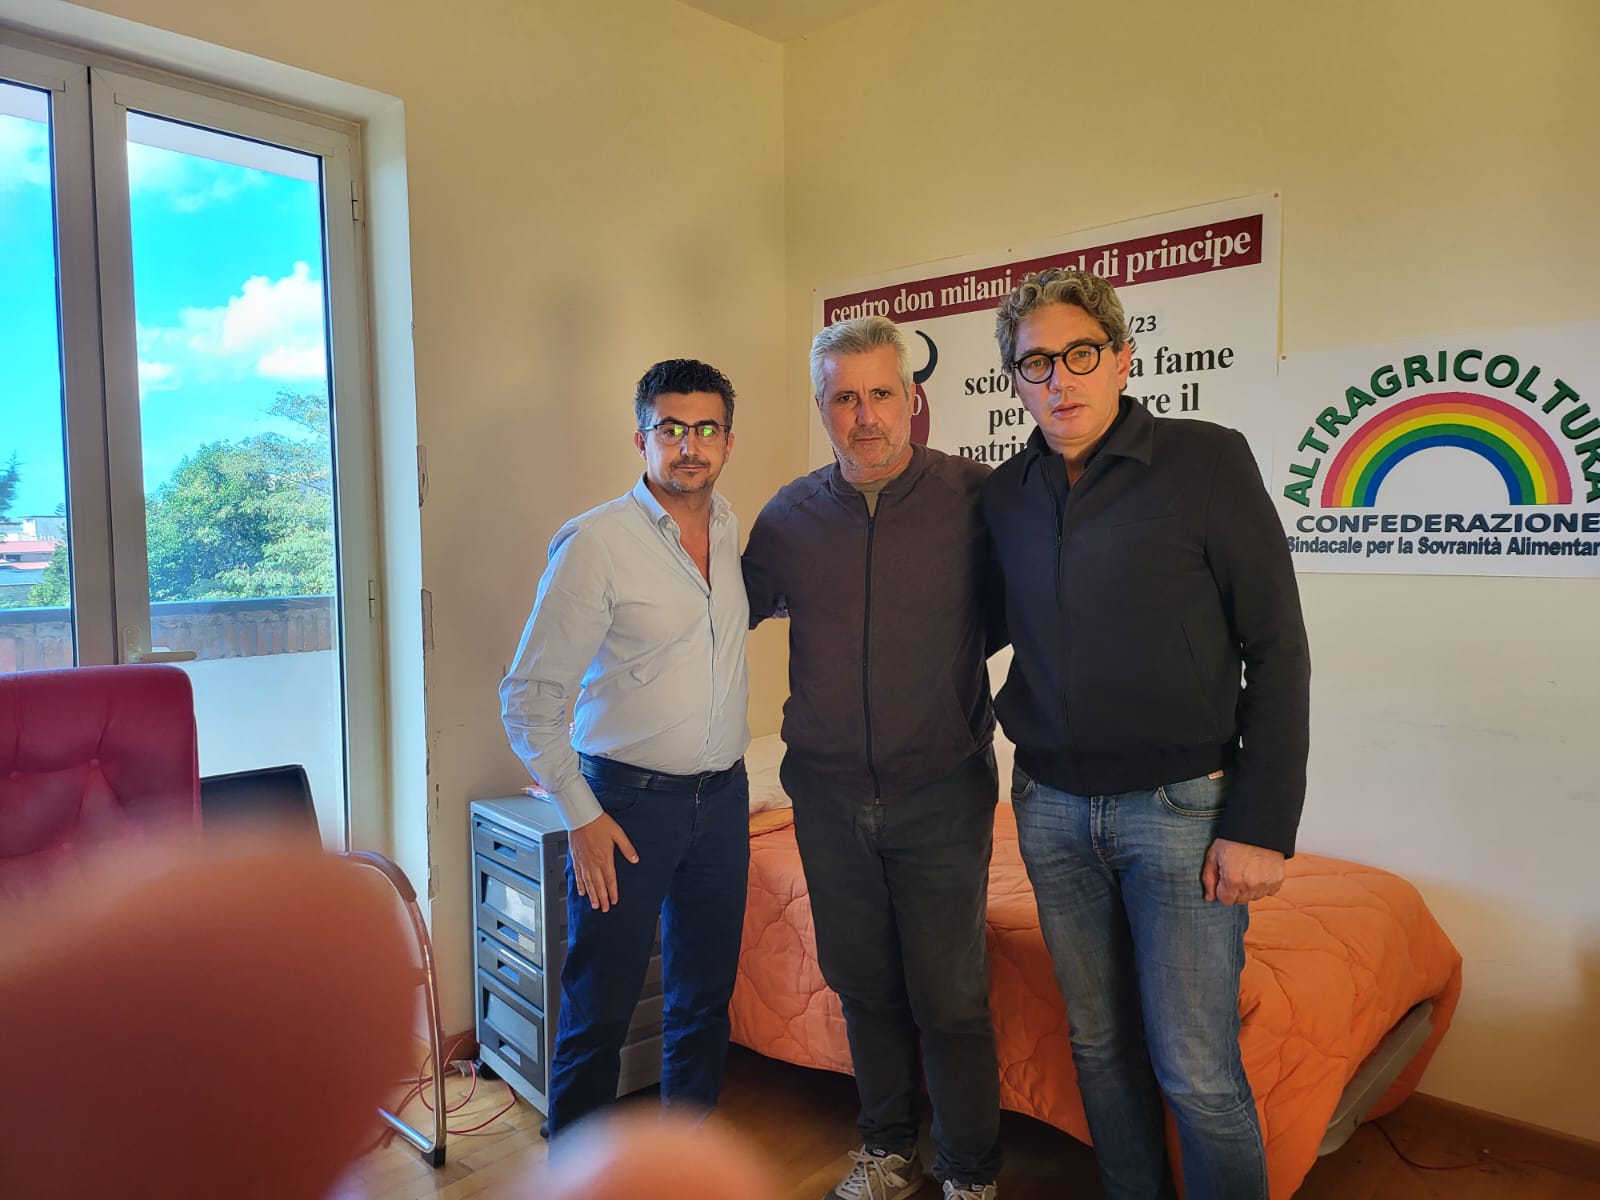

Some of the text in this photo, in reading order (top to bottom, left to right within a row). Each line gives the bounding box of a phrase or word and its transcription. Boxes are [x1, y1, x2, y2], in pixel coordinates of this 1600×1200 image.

[830, 298, 890, 323] centro
[894, 288, 935, 315] don
[1093, 248, 1120, 279] di
[1126, 230, 1251, 283] principe
[1128, 315, 1157, 334] /23
[1128, 357, 1144, 378] a
[1154, 346, 1234, 375] fame
[1140, 393, 1171, 414] re
[1180, 383, 1200, 412] il
[1283, 349, 1600, 507] ALTRAGRICOLTURA
[959, 435, 1027, 463] patri
[1296, 512, 1600, 533] CONFEDERAZIONE
[1287, 535, 1362, 554] Sindacale
[1366, 539, 1394, 558] per
[1398, 536, 1413, 554] la
[1418, 536, 1501, 555] Sovranità
